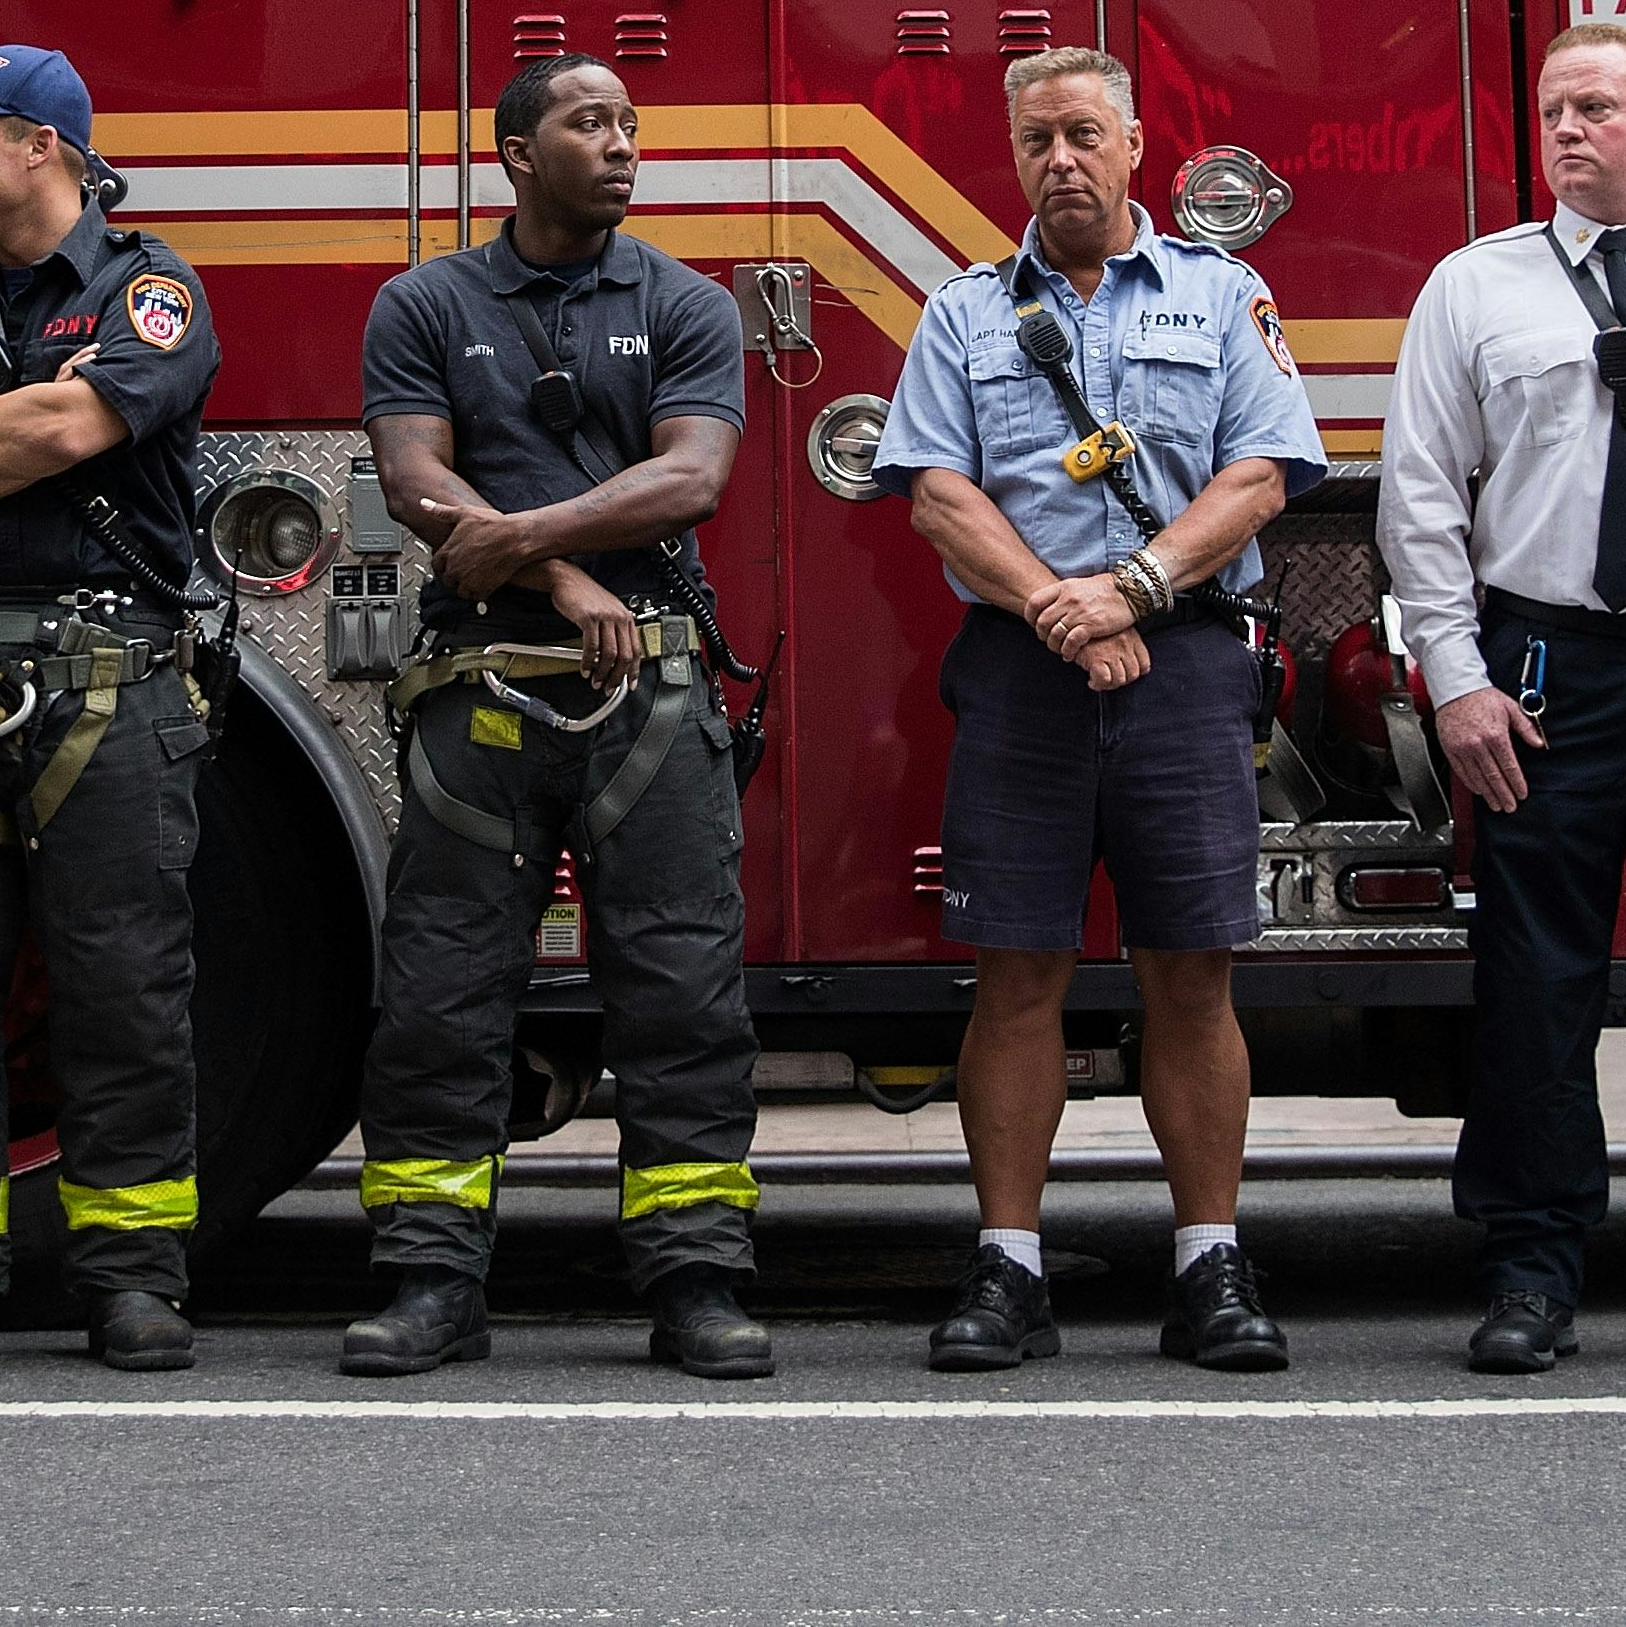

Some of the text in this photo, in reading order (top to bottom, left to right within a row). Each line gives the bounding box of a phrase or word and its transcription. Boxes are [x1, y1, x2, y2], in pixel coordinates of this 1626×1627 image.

[608, 324, 649, 356] FDN
[465, 344, 495, 358] SMITH
[942, 886, 971, 909] DNY
[543, 908, 576, 919] UTION
